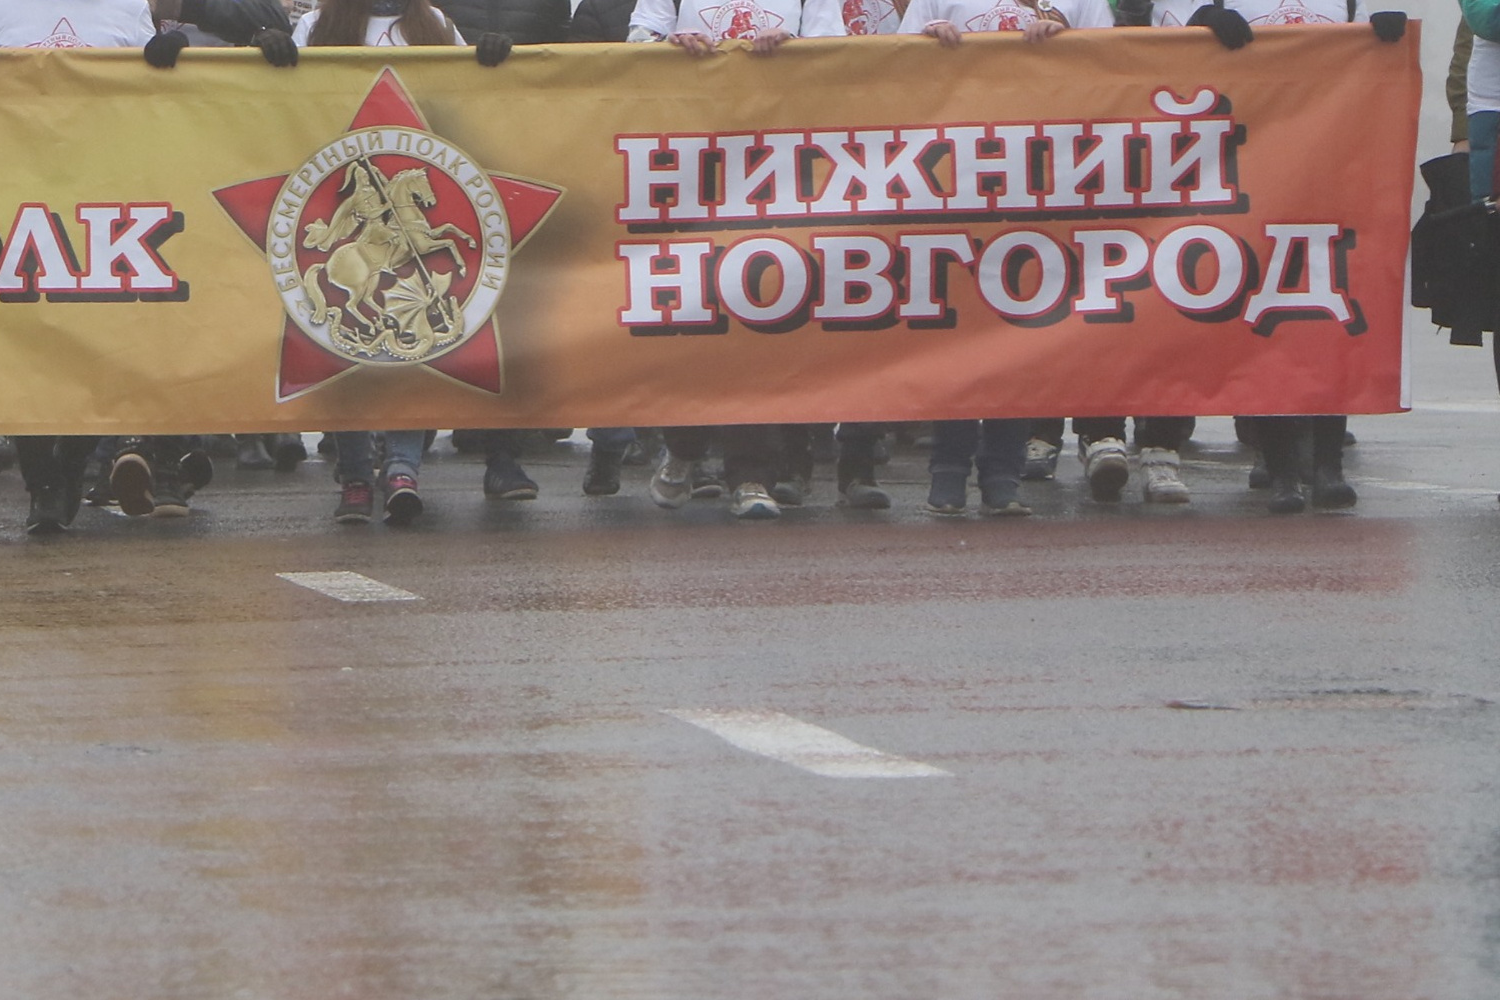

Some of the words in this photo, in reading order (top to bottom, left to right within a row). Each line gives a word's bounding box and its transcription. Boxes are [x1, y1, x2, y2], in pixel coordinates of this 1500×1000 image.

[272, 131, 383, 292] БЕССМЕРТНЫЙ
[396, 133, 467, 176] ПОЛК
[465, 176, 505, 289] РОССИИ
[615, 88, 1240, 225] НИЖНИЙ
[615, 221, 1357, 330] НОВГОРОД
